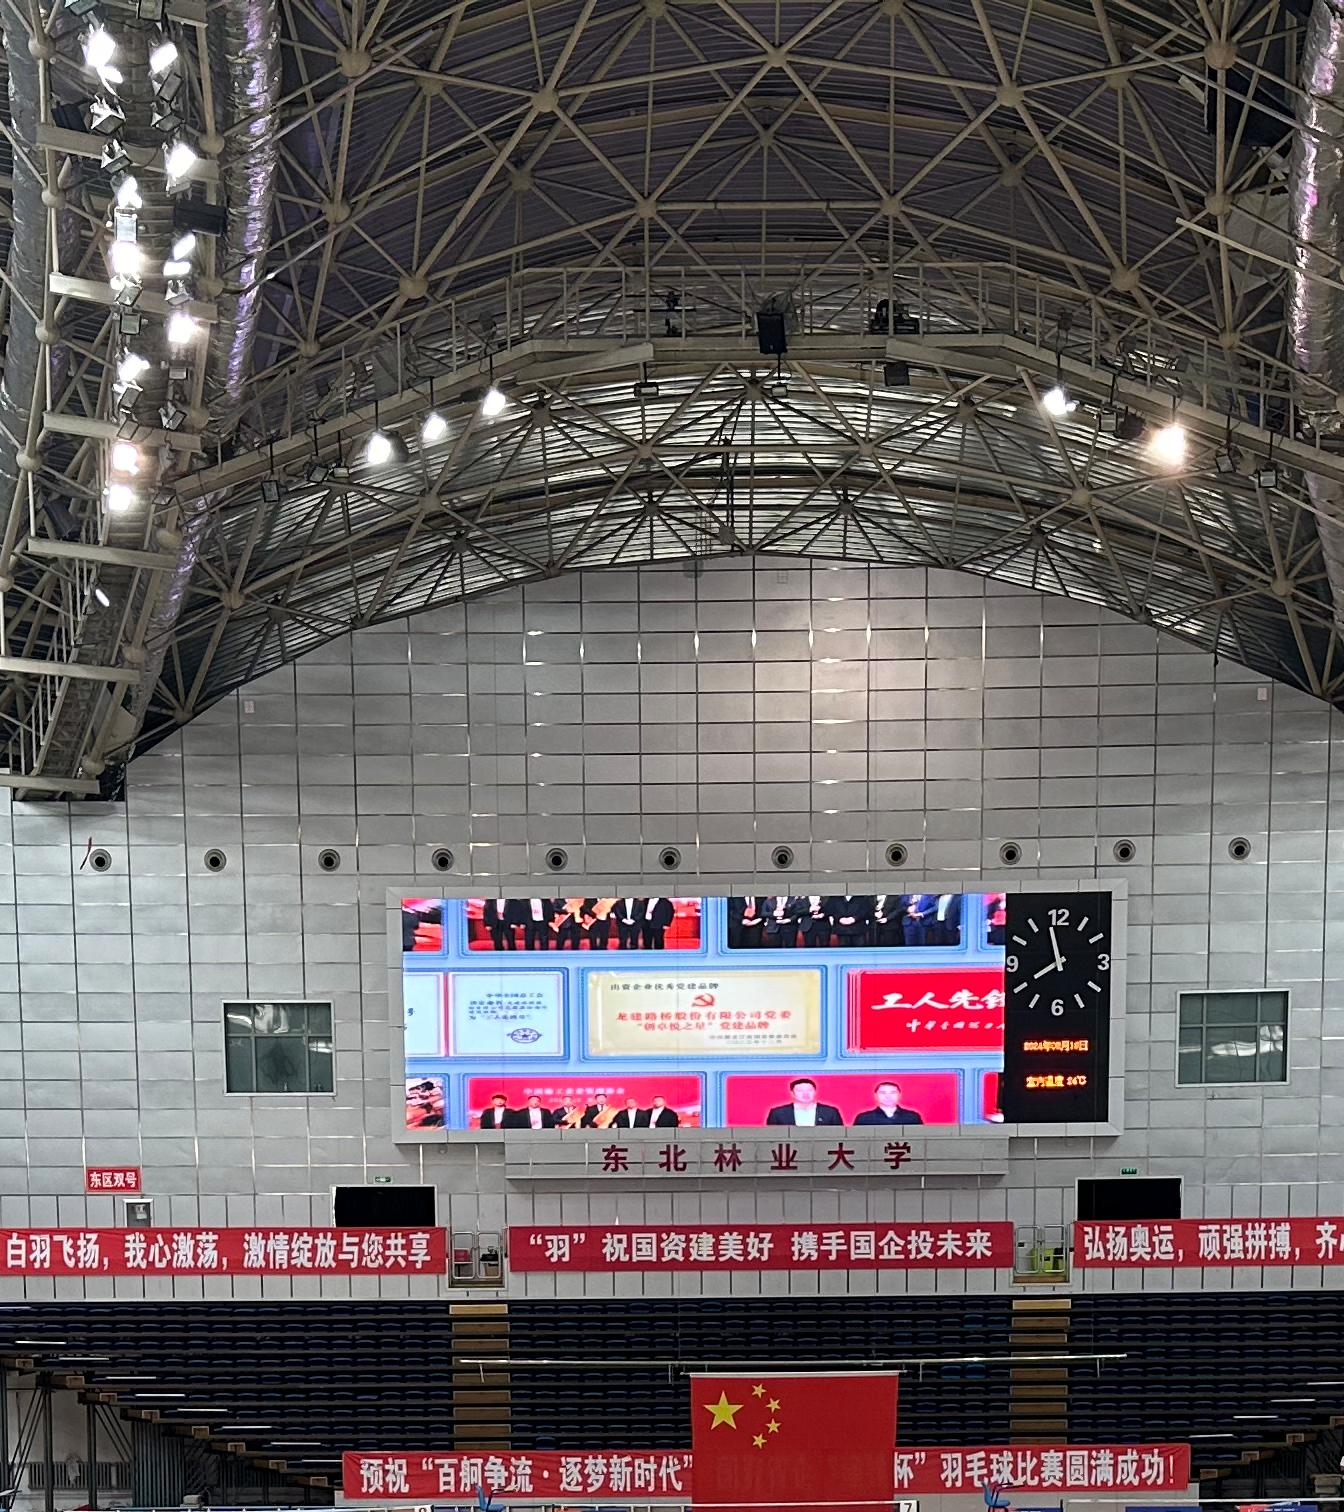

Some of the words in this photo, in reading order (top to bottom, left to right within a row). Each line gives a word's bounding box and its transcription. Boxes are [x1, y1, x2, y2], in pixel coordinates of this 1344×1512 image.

[1047, 909, 1070, 926] 12
[1006, 955, 1019, 973] 9
[1097, 953, 1111, 971] 3
[1051, 999, 1065, 1016] 6
[601, 1141, 913, 1174] 东北林业大学
[89, 1171, 138, 1190] 东区双号
[6, 1231, 432, 1271] 白羽飞扬,我心激荡,激情绽放与您共享
[790, 1228, 994, 1262] 携手国企投未来
